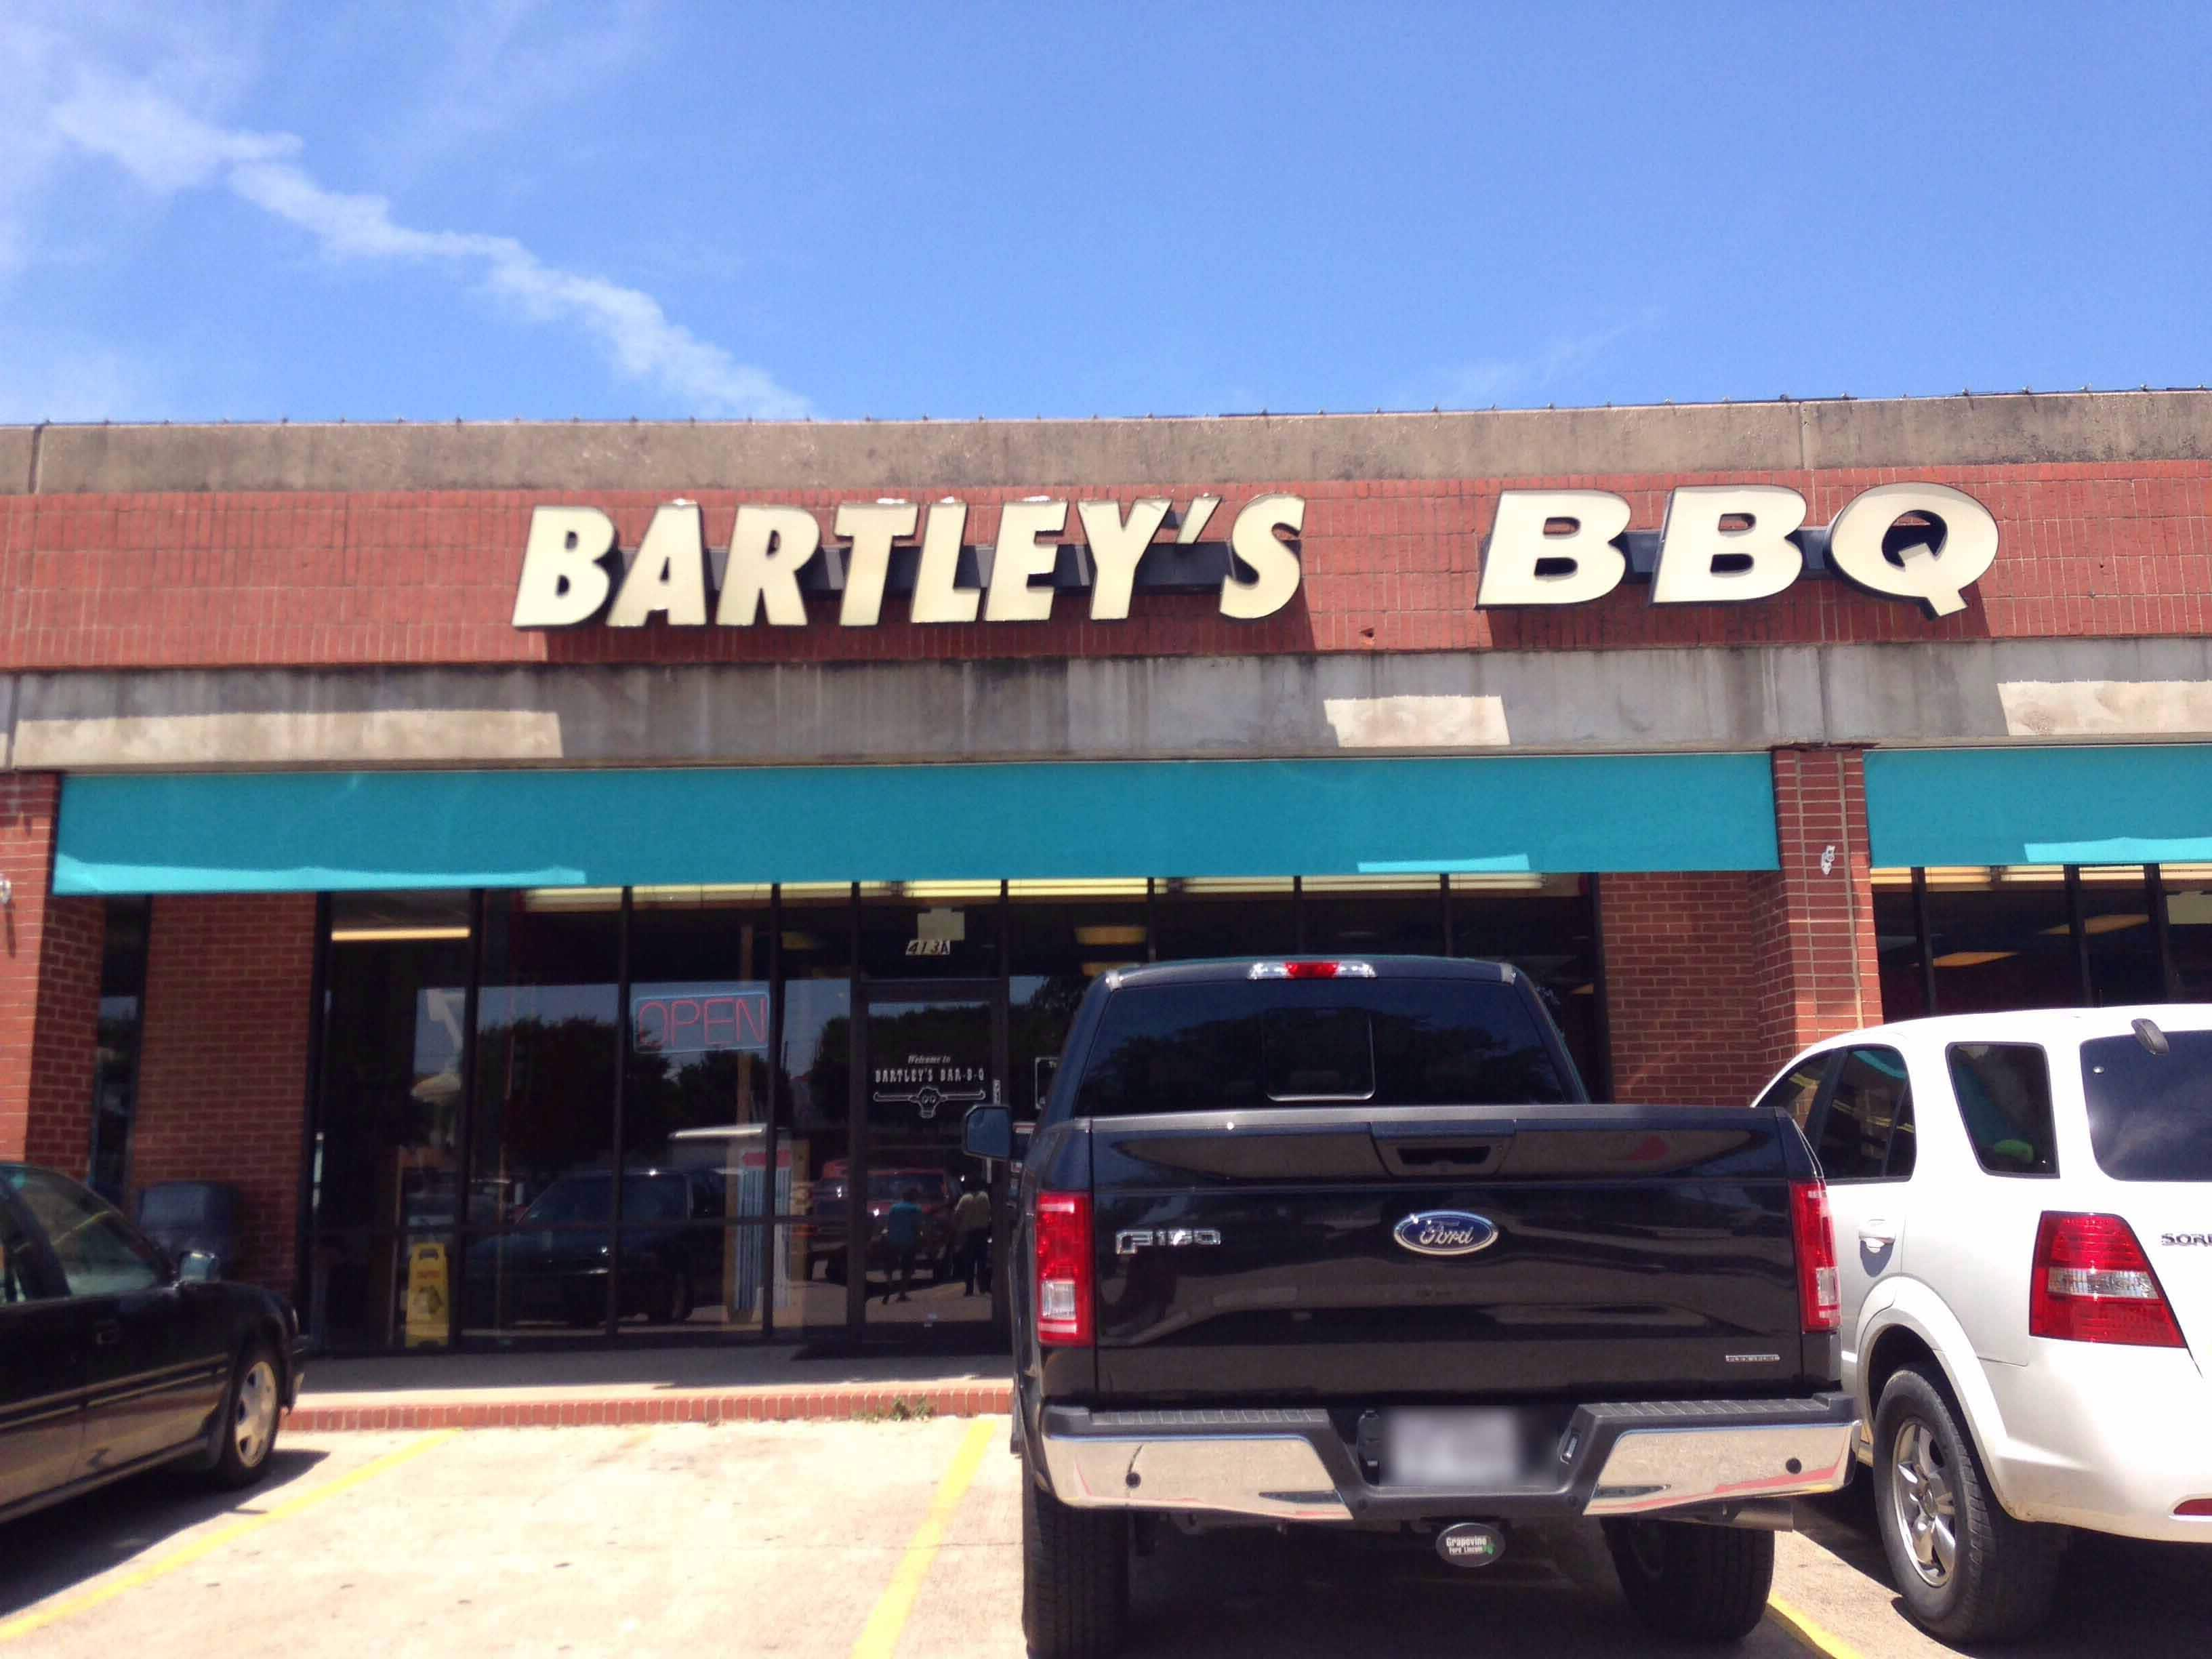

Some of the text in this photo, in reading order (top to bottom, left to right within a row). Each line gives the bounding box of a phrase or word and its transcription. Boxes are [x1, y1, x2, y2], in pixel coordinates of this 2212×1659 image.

[512, 481, 2000, 630] BARTLEY'S BBQ
[638, 996, 767, 1049] OPEN
[907, 1054, 951, 1064] Welcome to
[875, 1067, 985, 1083] BARTLEY'S BAR-B-Q
[1419, 1221, 1475, 1245] Ford
